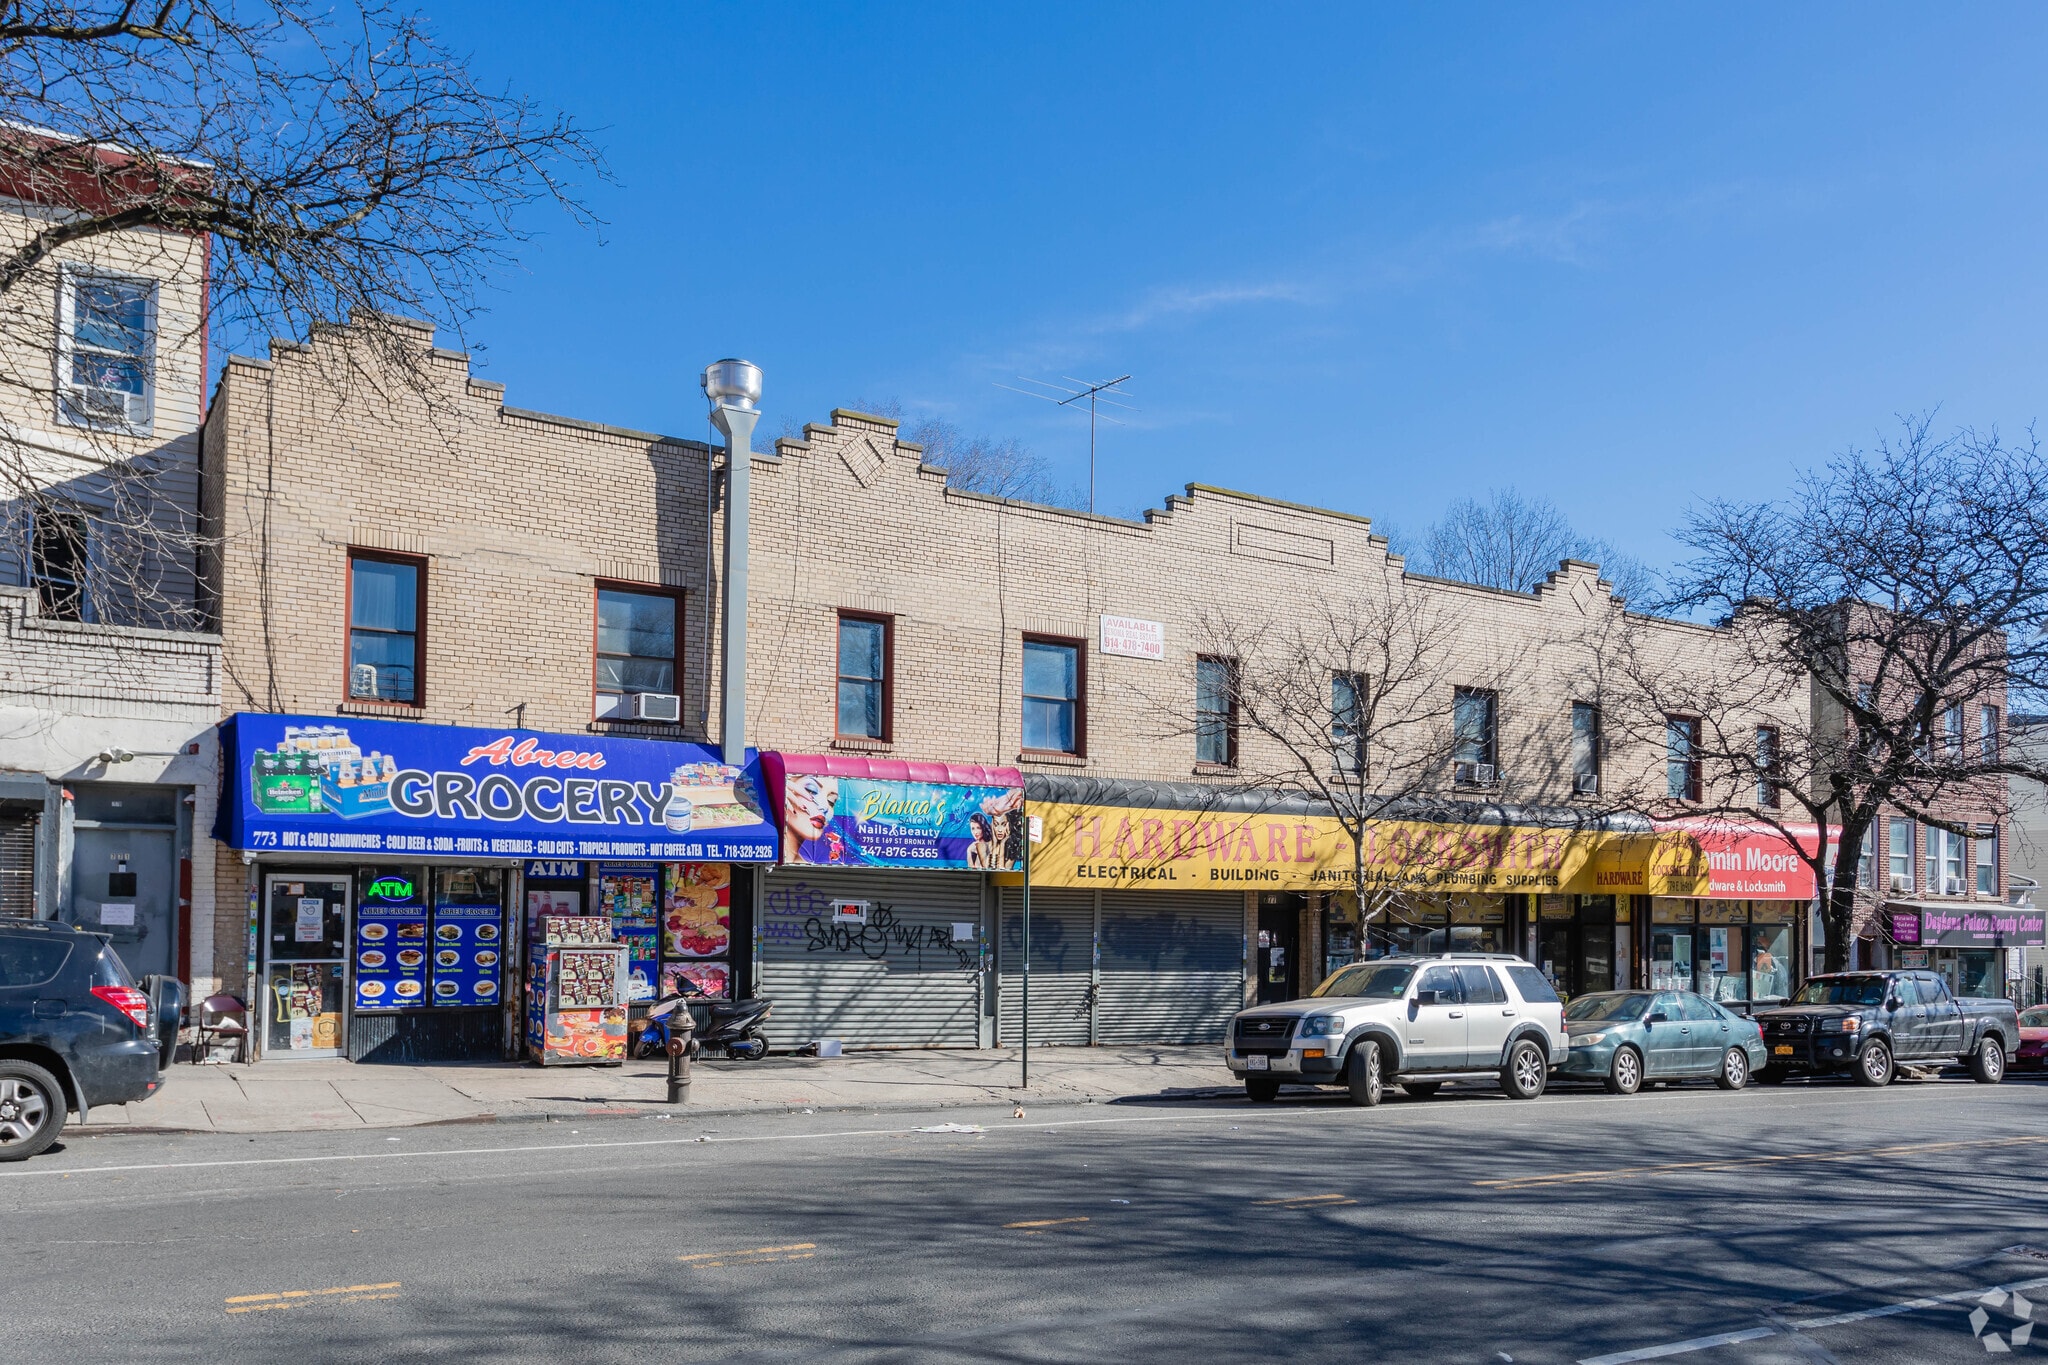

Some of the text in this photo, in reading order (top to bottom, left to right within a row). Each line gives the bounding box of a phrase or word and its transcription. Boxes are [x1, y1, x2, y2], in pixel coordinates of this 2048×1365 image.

[1106, 618, 1157, 633] AVAILABLE
[461, 736, 606, 770] Abreu
[387, 769, 673, 825] GROCERY
[859, 790, 946, 826] Bianca's
[898, 816, 931, 826] SALON
[253, 831, 277, 846] 773
[283, 832, 299, 846] HOT
[301, 834, 306, 846] &
[308, 832, 328, 847] COLD
[330, 833, 381, 849] SANDWICHES
[387, 835, 406, 850] COLD
[407, 836, 425, 850] BEER
[427, 839, 432, 851] &
[434, 837, 453, 851] SODA
[483, 841, 489, 852] &
[492, 839, 532, 853] VEGETABLES
[538, 841, 555, 854] COLD
[557, 841, 574, 854] CUTS
[579, 842, 610, 855] TROPICAL
[612, 843, 645, 856] PRODUCTS
[650, 844, 663, 856] HOT
[664, 844, 685, 856] COFFEE
[707, 845, 722, 858] TEL.
[724, 845, 772, 858] 718-328-2926
[1072, 814, 1316, 863] HARDWARE
[1367, 826, 1562, 871] LOCKSMITH
[860, 845, 938, 858] 347-876-6365
[1704, 846, 1741, 871] min
[1746, 848, 1798, 872] Moore
[529, 861, 579, 877] ATM
[1077, 865, 1177, 881] ELECTRICAL
[1210, 868, 1279, 881] BUILDING
[1402, 873, 1428, 884] AND
[1437, 873, 1497, 886] PLUMBING
[1506, 874, 1559, 887] SUPPLIES
[1596, 871, 1643, 885] HARDWARE
[1709, 879, 1786, 892] dware & Locksmith
[368, 882, 413, 896] ATM
[362, 907, 422, 915] ABREU GROCERY
[464, 908, 496, 916] GROCERY
[1963, 913, 1988, 931] Palace
[1990, 915, 2017, 935] Beauty
[2019, 914, 2043, 932] Center
